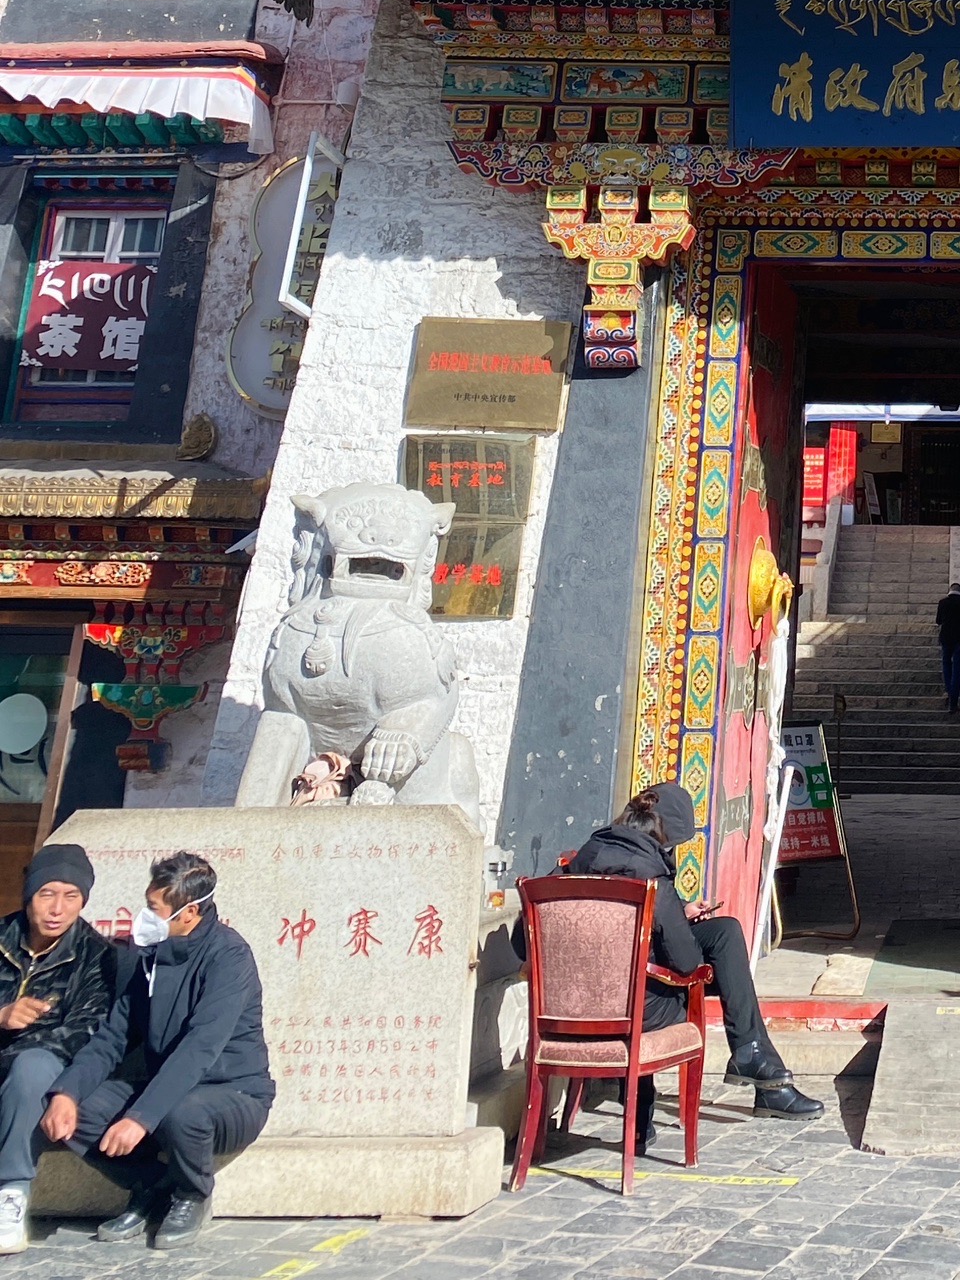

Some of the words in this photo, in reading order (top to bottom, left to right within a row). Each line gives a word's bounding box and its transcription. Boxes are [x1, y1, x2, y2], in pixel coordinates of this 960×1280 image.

[36, 314, 146, 360] 茶馆
[453, 392, 516, 403] 中共中央宣传部
[426, 473, 504, 488] 教育基地
[432, 563, 503, 587] 教学基地
[784, 734, 814, 747] 戴口罩
[784, 811, 827, 826] 自觉排队
[780, 835, 830, 850] 保持一米线
[271, 843, 460, 862] 全国重点文物保护单位
[277, 905, 443, 961] 冲赛康
[270, 1015, 442, 1029] 中华人民共和国国务院
[267, 1040, 439, 1055] 元2013年3月5日公布
[282, 1063, 437, 1078] 西藏自治区人民政府
